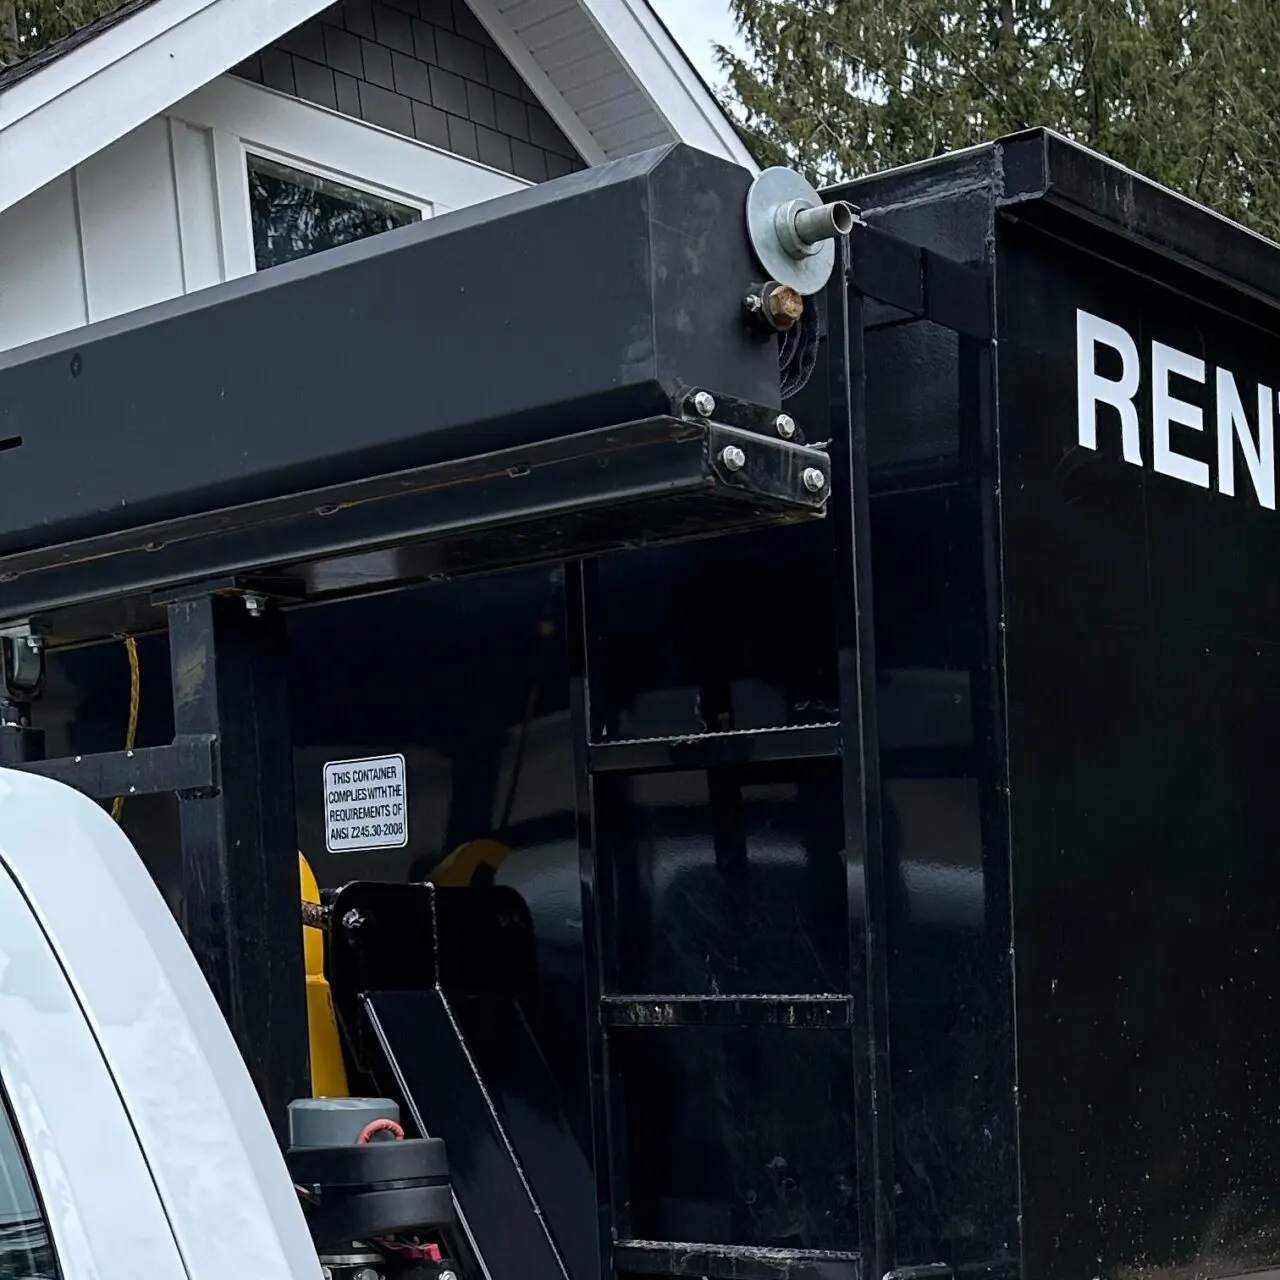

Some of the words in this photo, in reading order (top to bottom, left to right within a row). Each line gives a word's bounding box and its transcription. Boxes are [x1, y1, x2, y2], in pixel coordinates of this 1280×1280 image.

[332, 771, 351, 785] THIS
[352, 766, 397, 782] CONTAINER
[328, 787, 367, 804] COMPLIES
[367, 786, 387, 800] WITH
[388, 784, 403, 798] THE
[329, 804, 391, 822] REQUIREMENTS
[392, 803, 403, 816] OF
[331, 827, 349, 840] ANSI
[351, 822, 404, 839] Z245.30-2008
